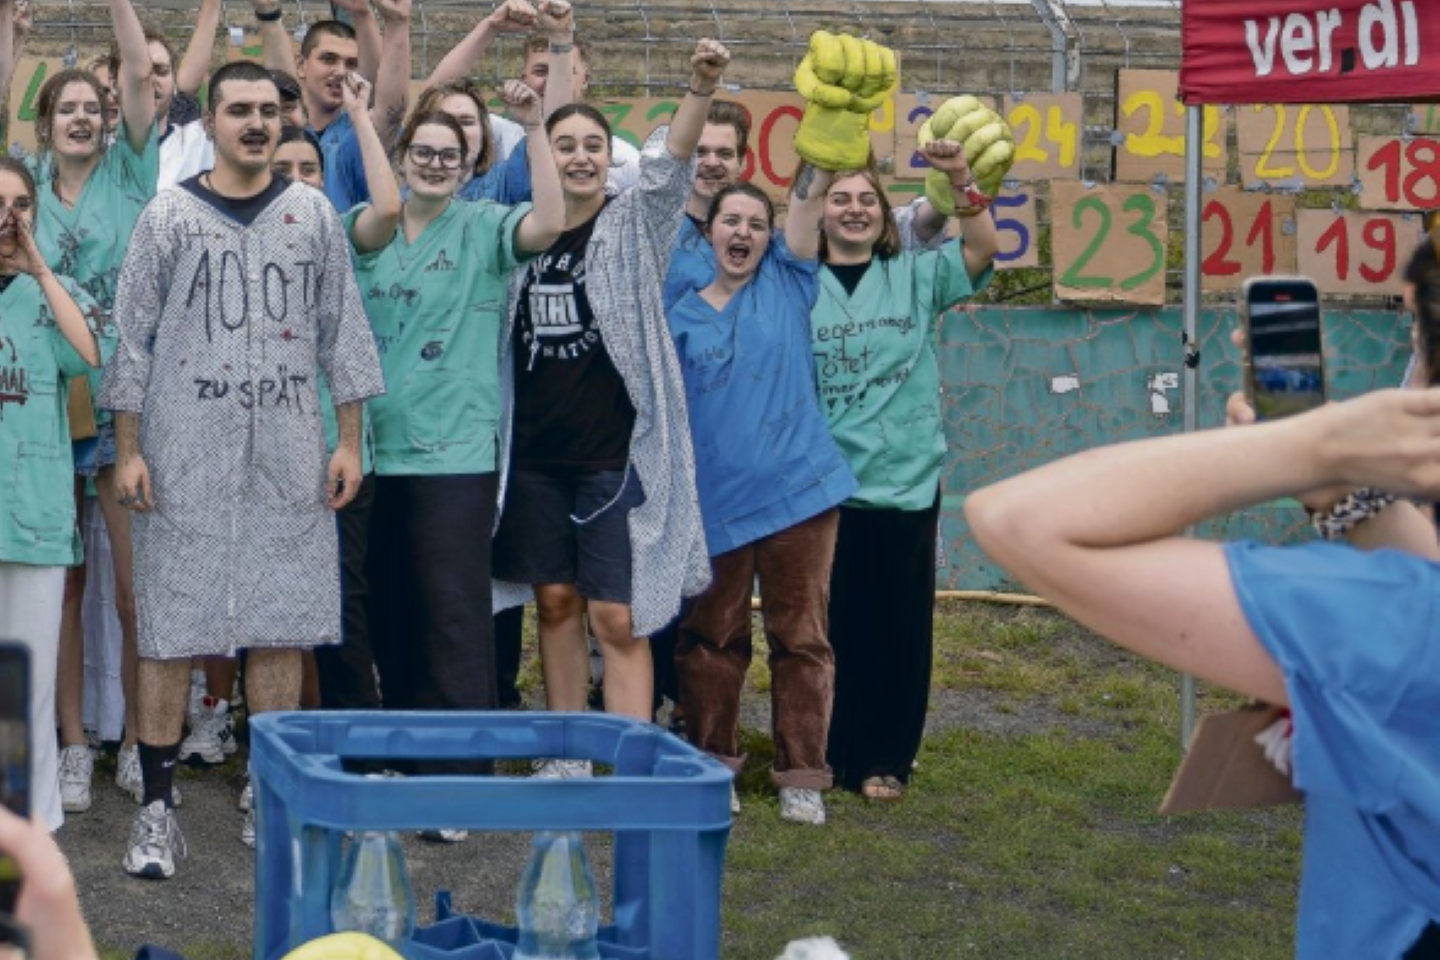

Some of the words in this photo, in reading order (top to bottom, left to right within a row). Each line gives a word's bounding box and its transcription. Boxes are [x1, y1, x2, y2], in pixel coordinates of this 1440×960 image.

[1007, 103, 1077, 168] 24
[1253, 104, 1341, 181] 20
[1366, 137, 1440, 210] 18
[990, 193, 1031, 262] 5
[1061, 193, 1166, 291] 23
[1201, 199, 1275, 277] 21
[1315, 215, 1397, 284] 19
[194, 377, 229, 401] ZU
